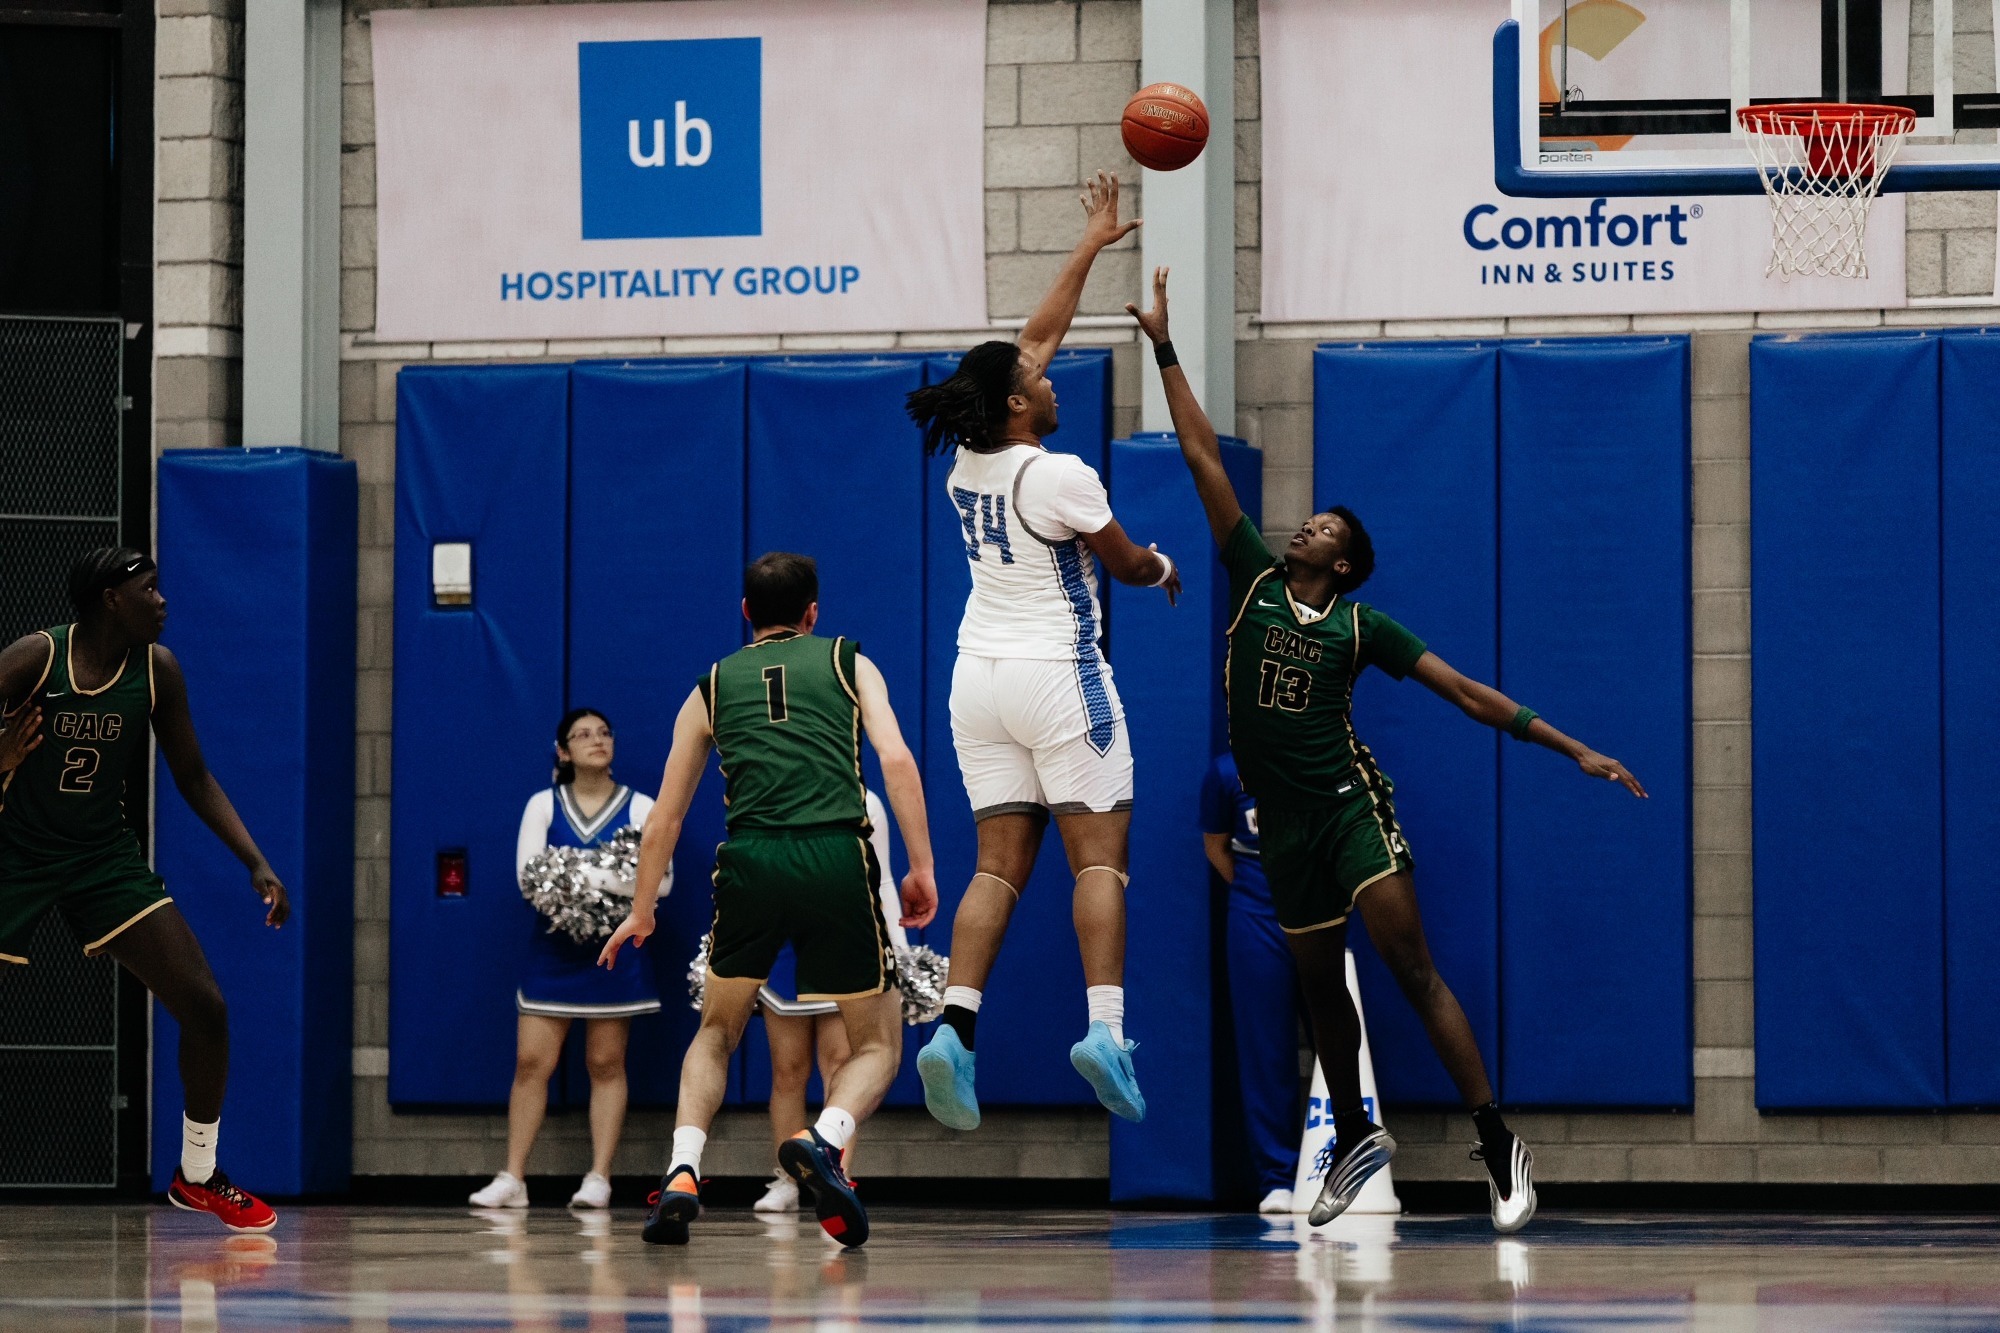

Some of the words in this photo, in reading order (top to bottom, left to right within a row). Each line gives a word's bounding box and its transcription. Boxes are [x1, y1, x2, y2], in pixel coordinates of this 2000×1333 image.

[627, 100, 713, 168] ub
[1140, 102, 1199, 132] SPALDING
[500, 268, 724, 301] HOSPITALITY
[733, 265, 860, 296] GROUP
[1481, 263, 1534, 285] INN
[1544, 263, 1562, 283] &
[1573, 260, 1675, 283] SUITES
[1264, 624, 1324, 664] CAC
[761, 664, 789, 724] 1
[1258, 658, 1313, 712] 13
[53, 711, 123, 742] CAC
[59, 746, 101, 793] 2
